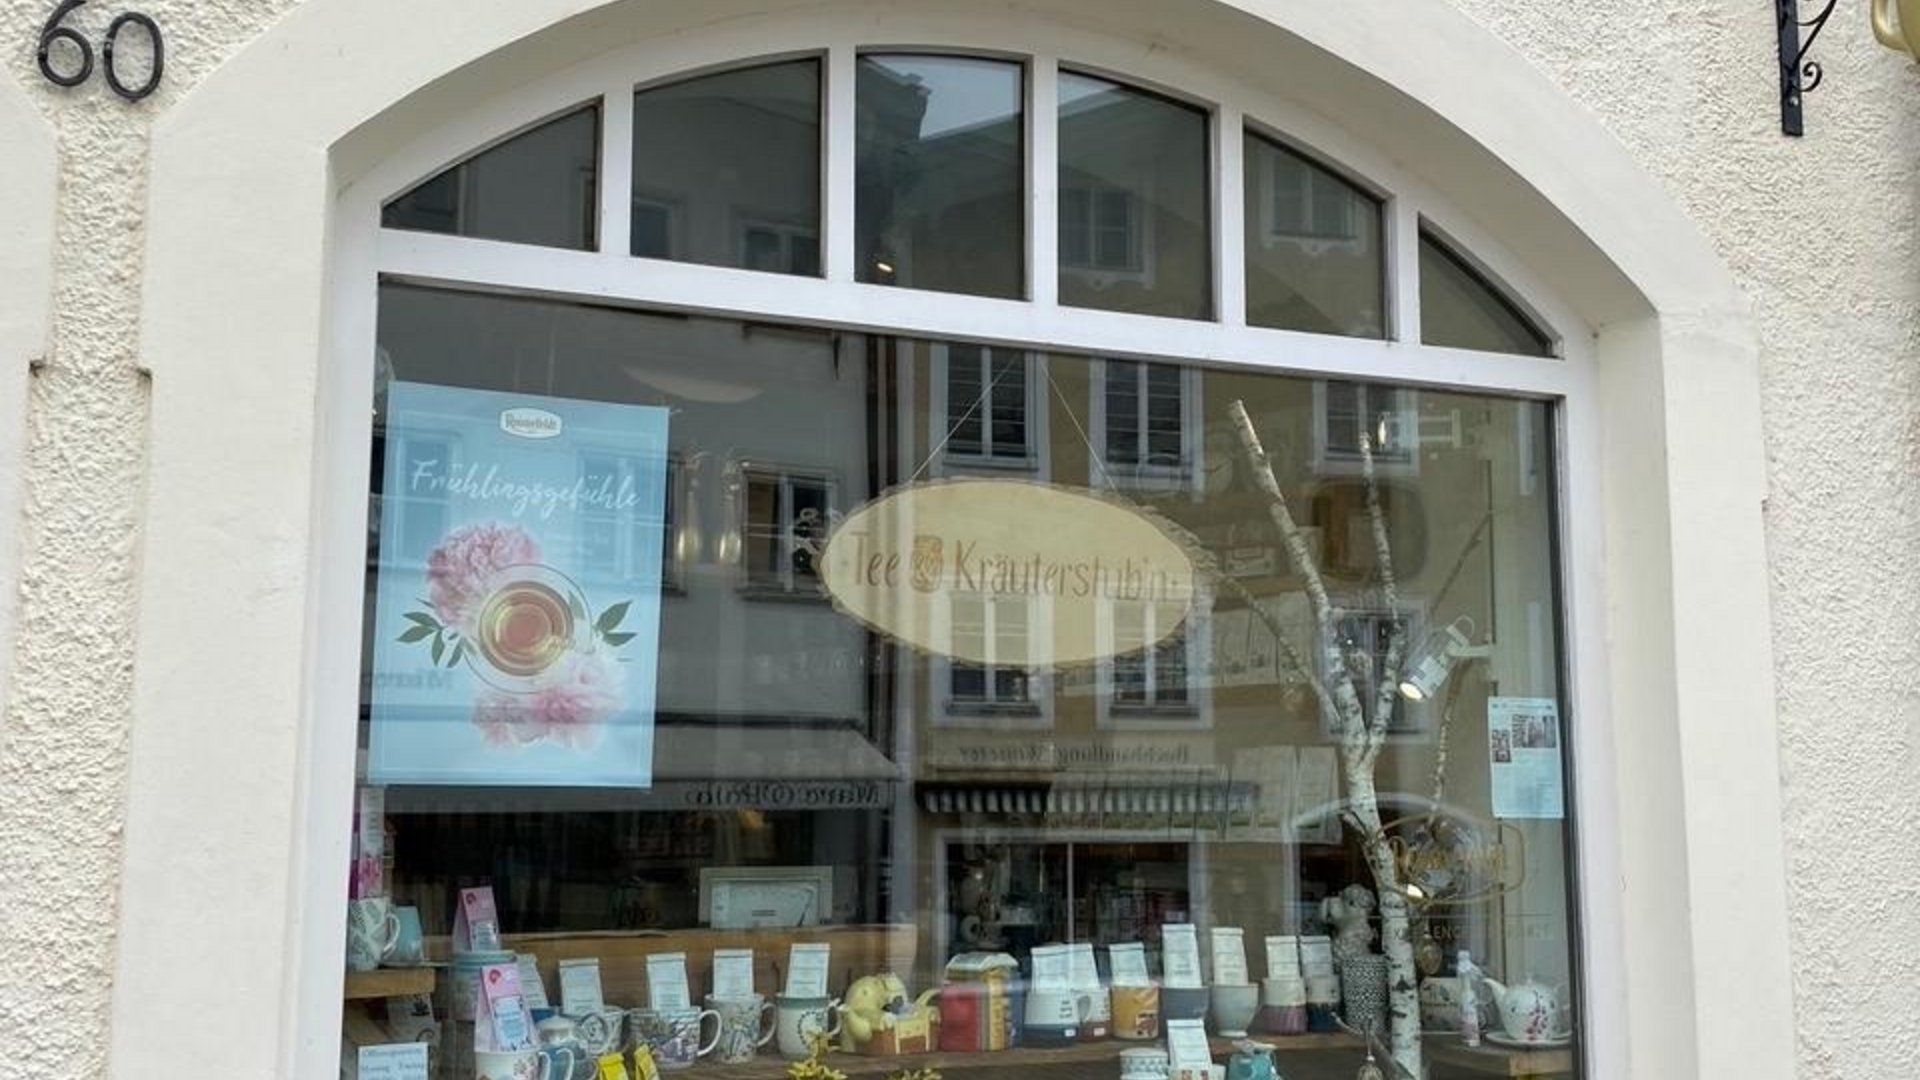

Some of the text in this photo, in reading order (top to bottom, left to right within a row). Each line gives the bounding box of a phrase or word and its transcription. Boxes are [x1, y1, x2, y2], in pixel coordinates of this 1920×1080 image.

[38, 0, 165, 99] 60
[411, 459, 640, 518] Frühlingsgefühle
[848, 531, 899, 588] Tee
